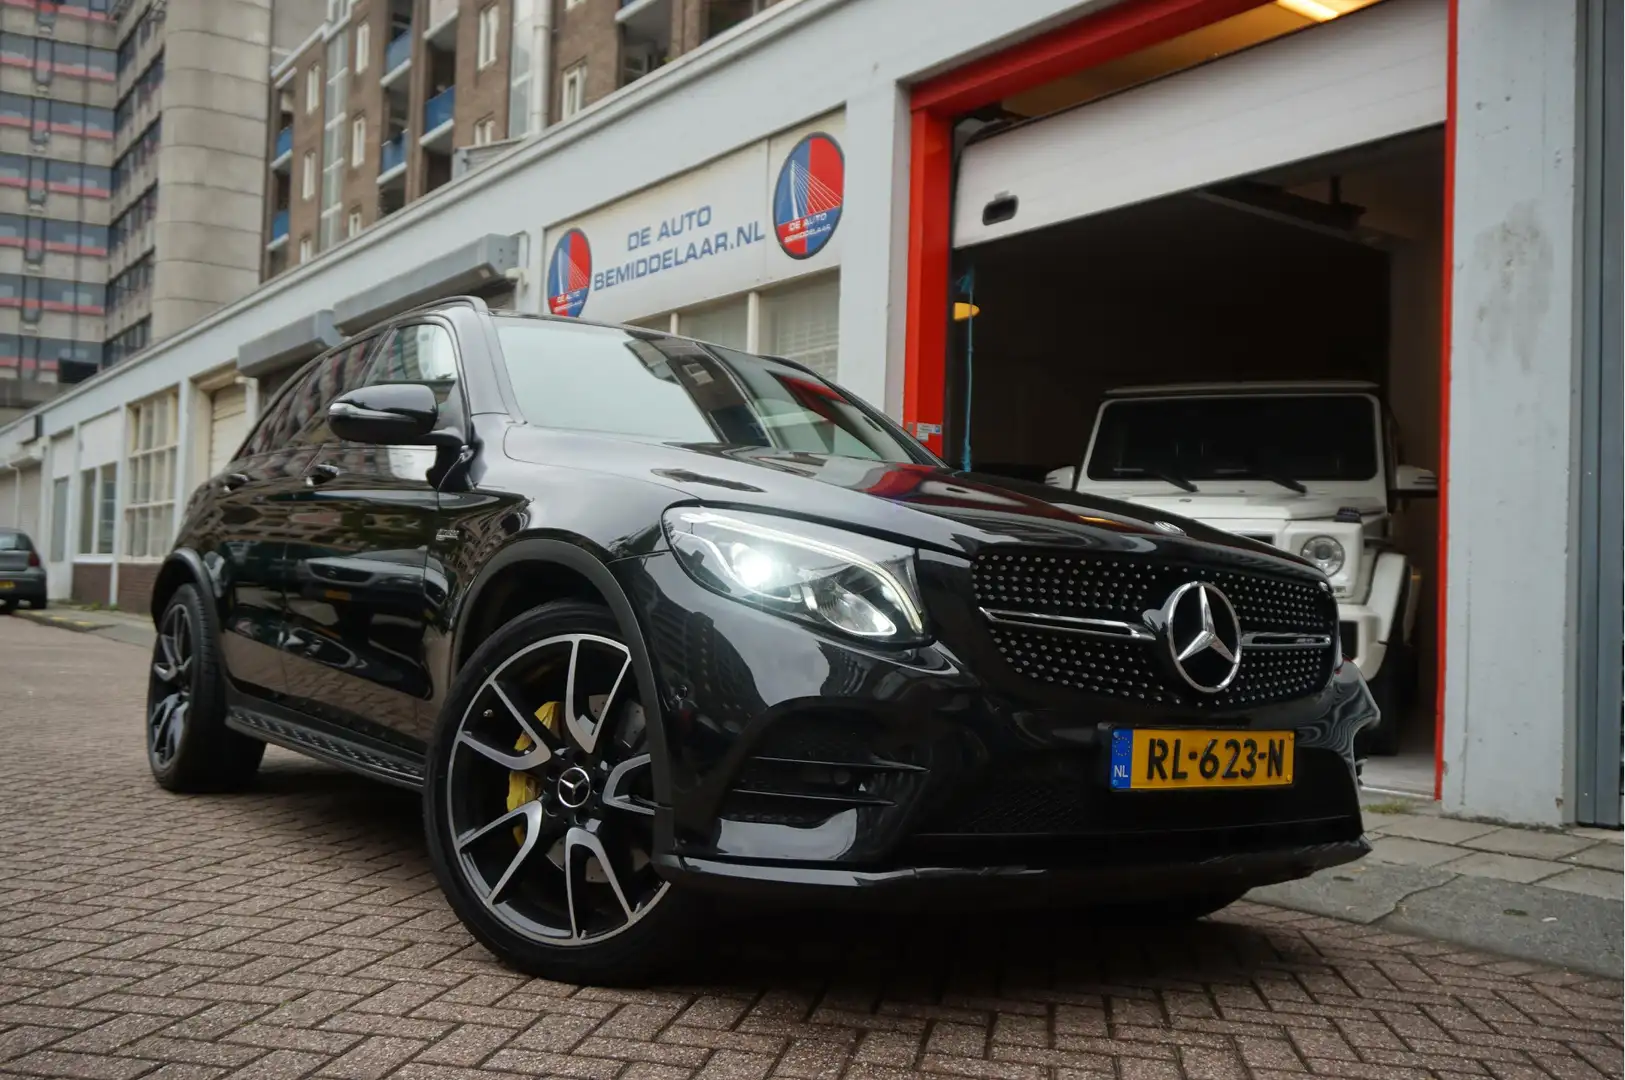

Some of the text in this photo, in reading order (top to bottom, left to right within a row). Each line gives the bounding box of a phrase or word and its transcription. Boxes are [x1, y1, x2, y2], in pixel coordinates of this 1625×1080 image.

[627, 205, 712, 252] DE AUTO
[784, 223, 831, 243] BEMIDDELAAR
[788, 212, 827, 232] DE AUTO
[594, 221, 766, 291] BEMIDDELAAR.NL
[1113, 765, 1129, 778] NL
[1147, 738, 1286, 781] RL-623-N
